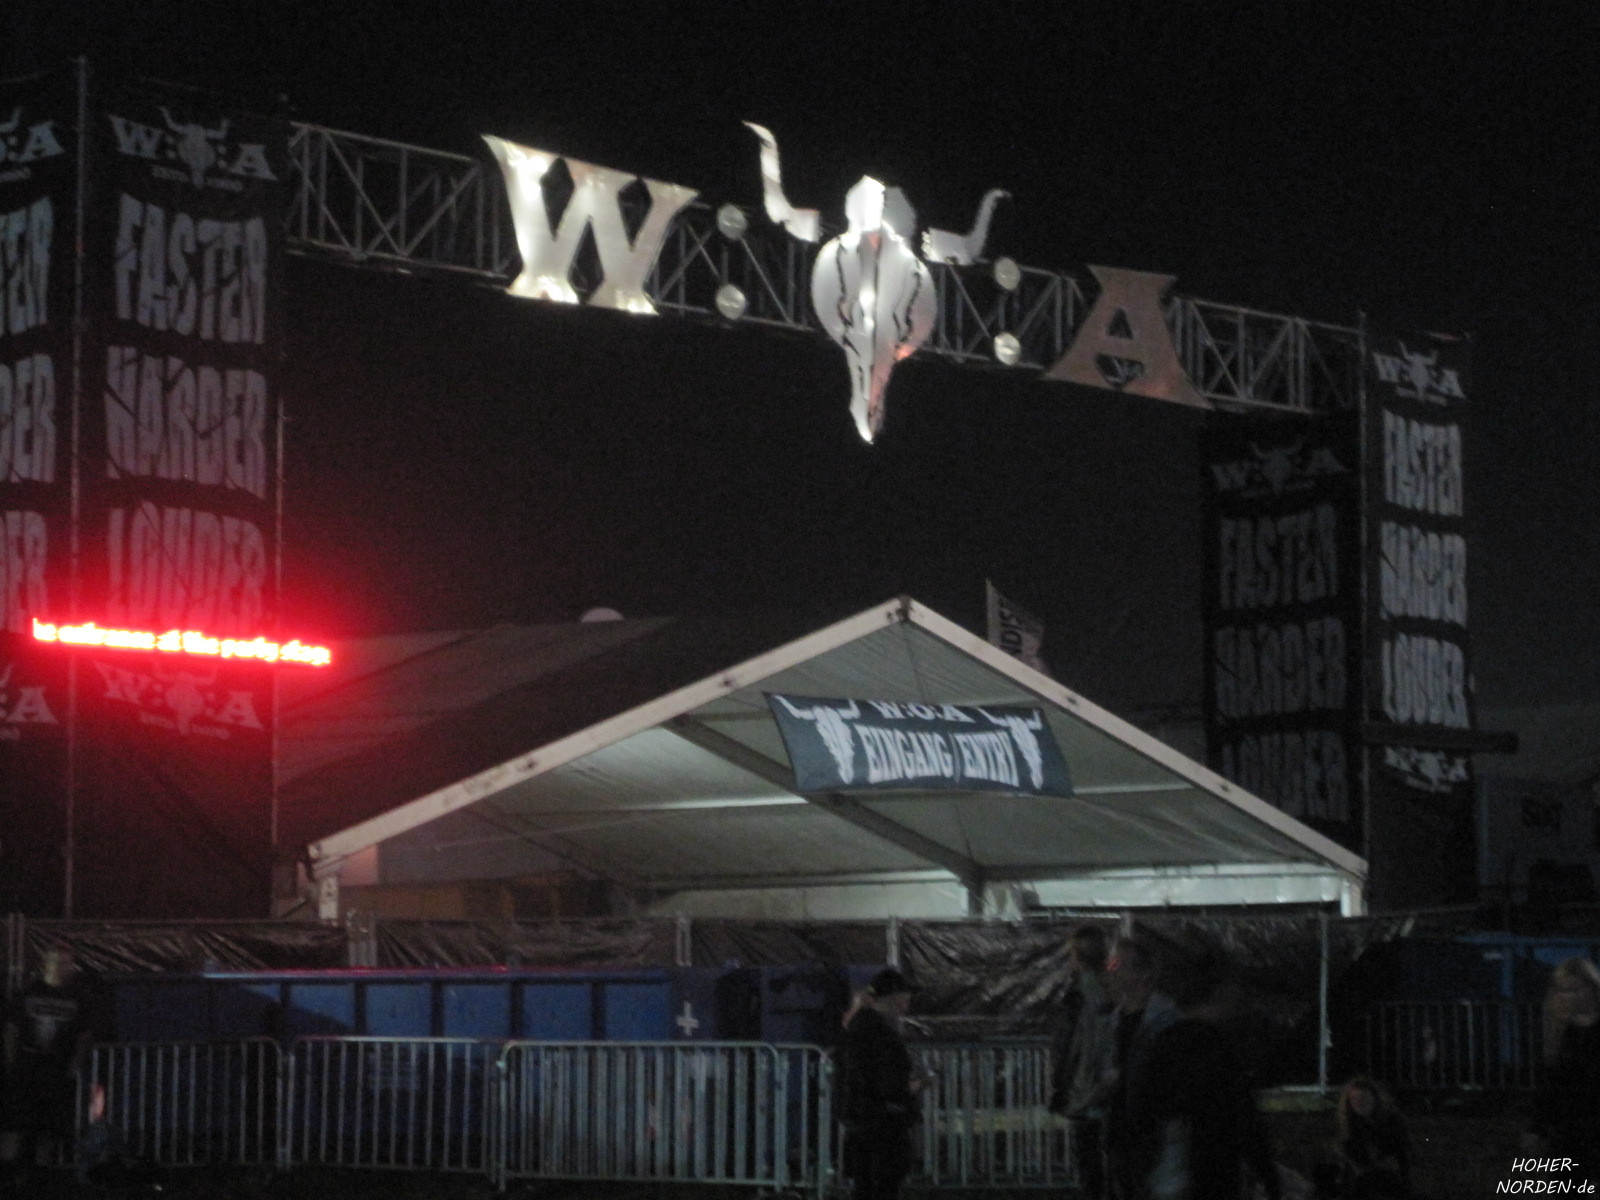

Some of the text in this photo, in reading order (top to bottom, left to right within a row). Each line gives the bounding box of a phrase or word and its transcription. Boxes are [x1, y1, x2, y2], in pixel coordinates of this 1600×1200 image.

[114, 192, 267, 344] FASTER
[103, 346, 267, 500] HARDER
[1382, 406, 1464, 517] FASTER
[1379, 519, 1468, 629] HARDER
